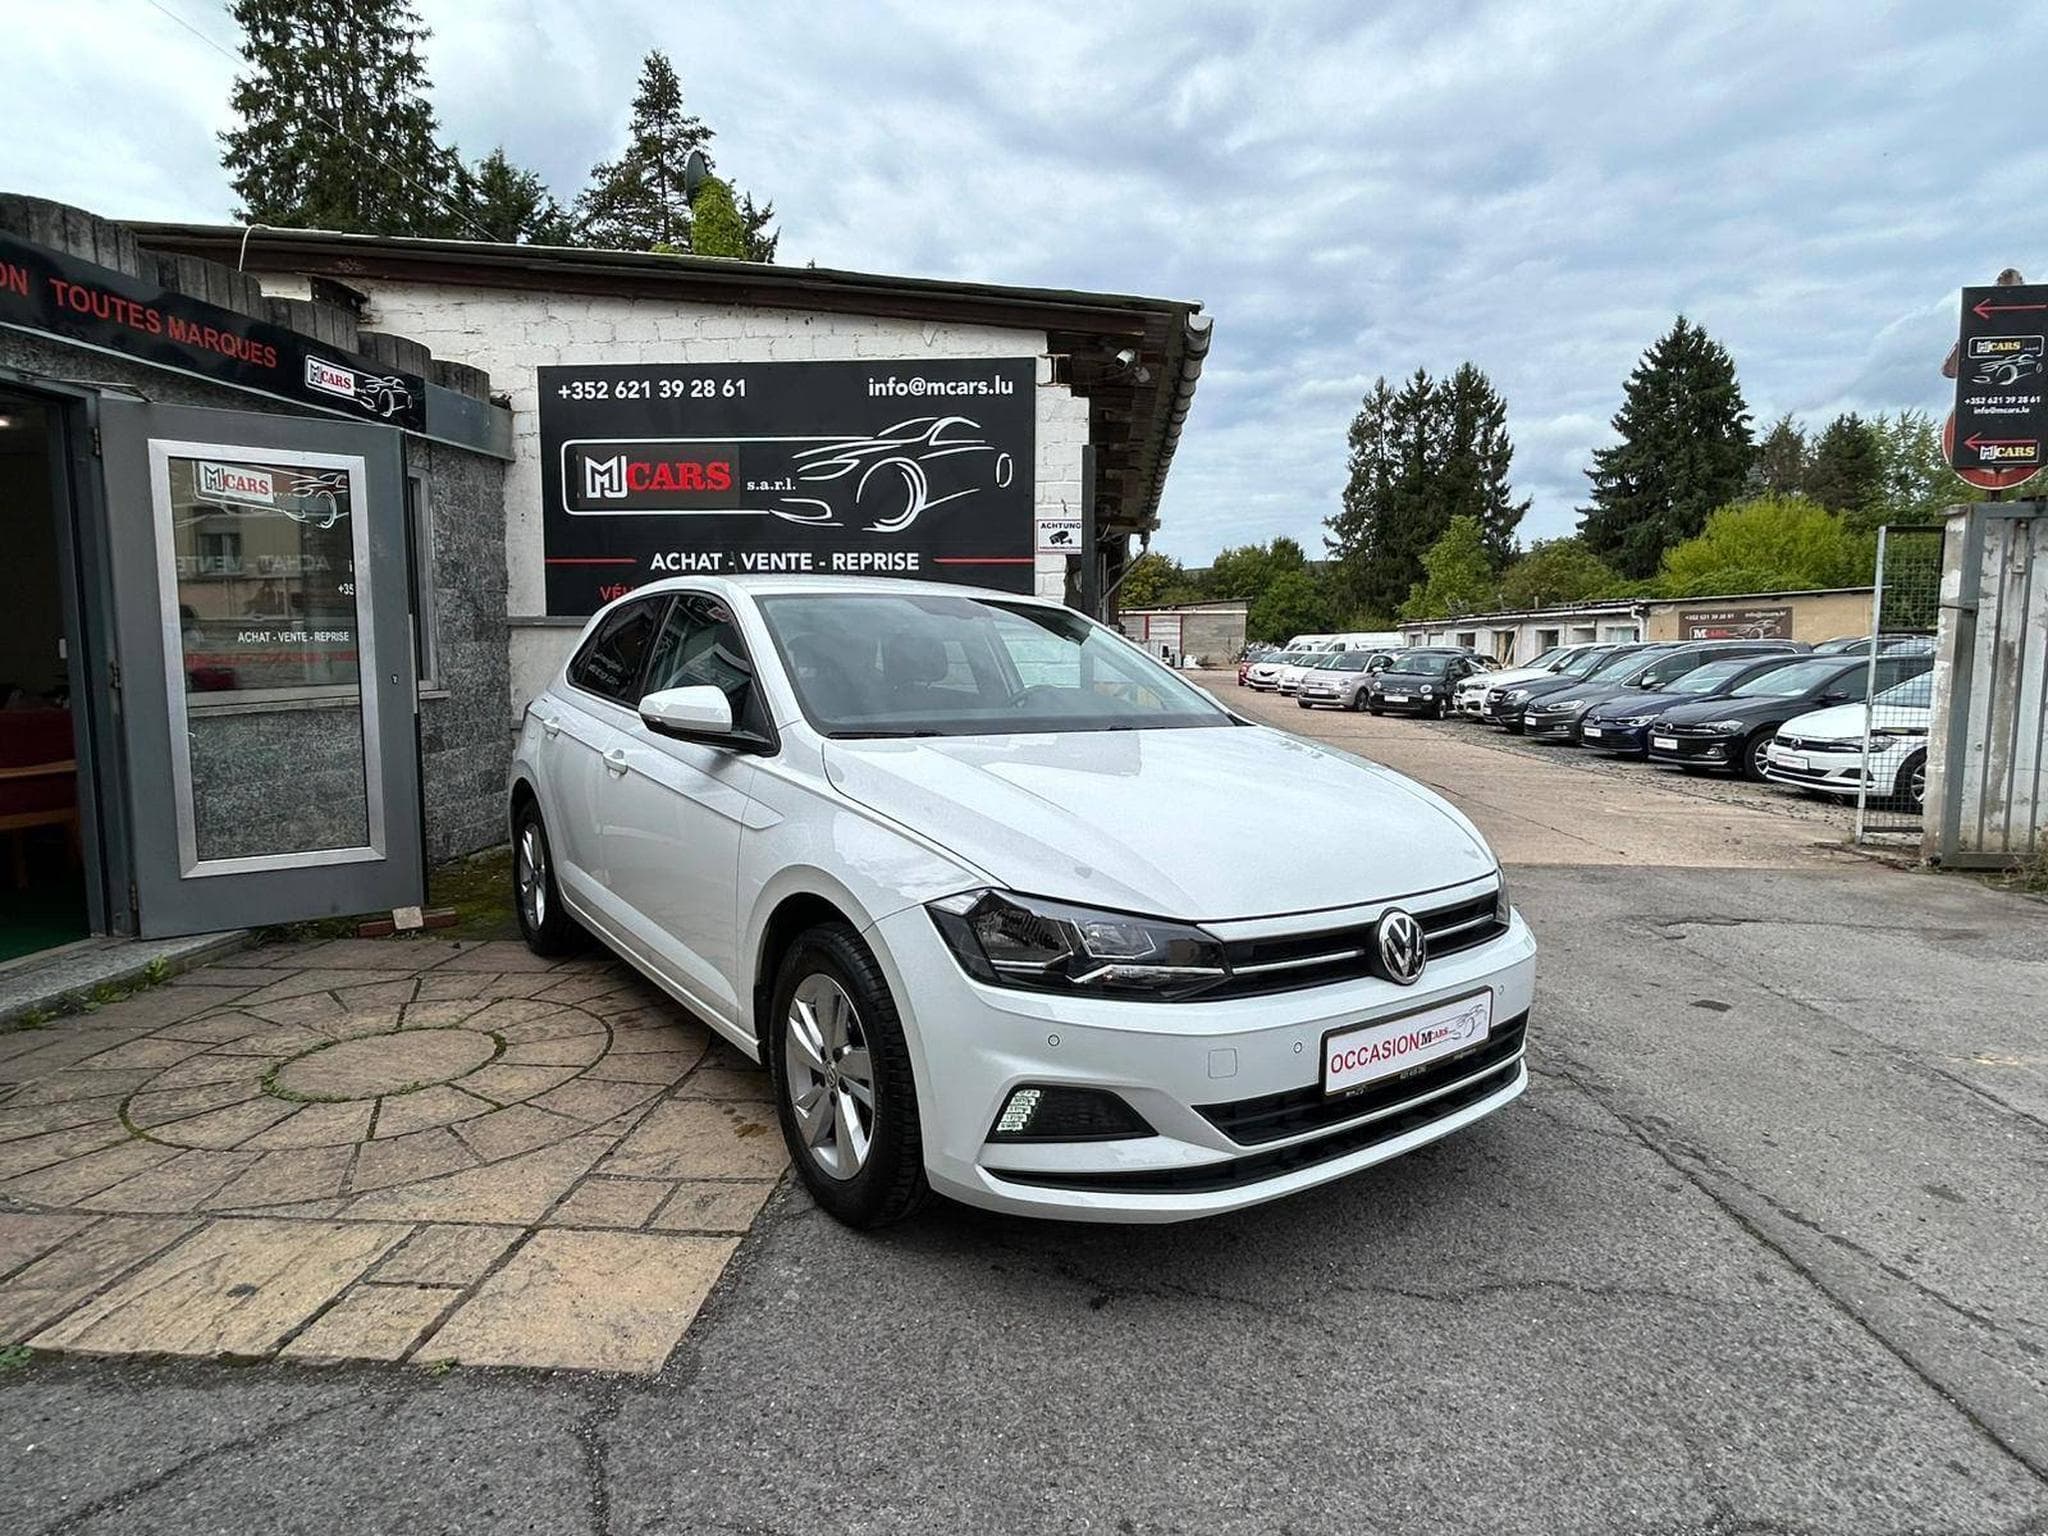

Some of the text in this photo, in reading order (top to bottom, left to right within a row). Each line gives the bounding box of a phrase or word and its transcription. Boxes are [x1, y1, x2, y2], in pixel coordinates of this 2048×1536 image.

[50, 277, 162, 334] TOUTES
[168, 315, 277, 368] MARQUES
[557, 378, 746, 400] +352 621 39 28 61
[868, 374, 1014, 397] info@mcars.lu
[746, 477, 796, 492] s.a.r.l.
[649, 551, 722, 571] ACHAT
[741, 551, 814, 571] VENTE
[832, 551, 919, 571] REPRISE
[238, 631, 271, 643] ACHAT
[278, 631, 309, 643] VENTE
[314, 631, 350, 642] REPRISE
[1331, 1031, 1420, 1074] OCCASION
